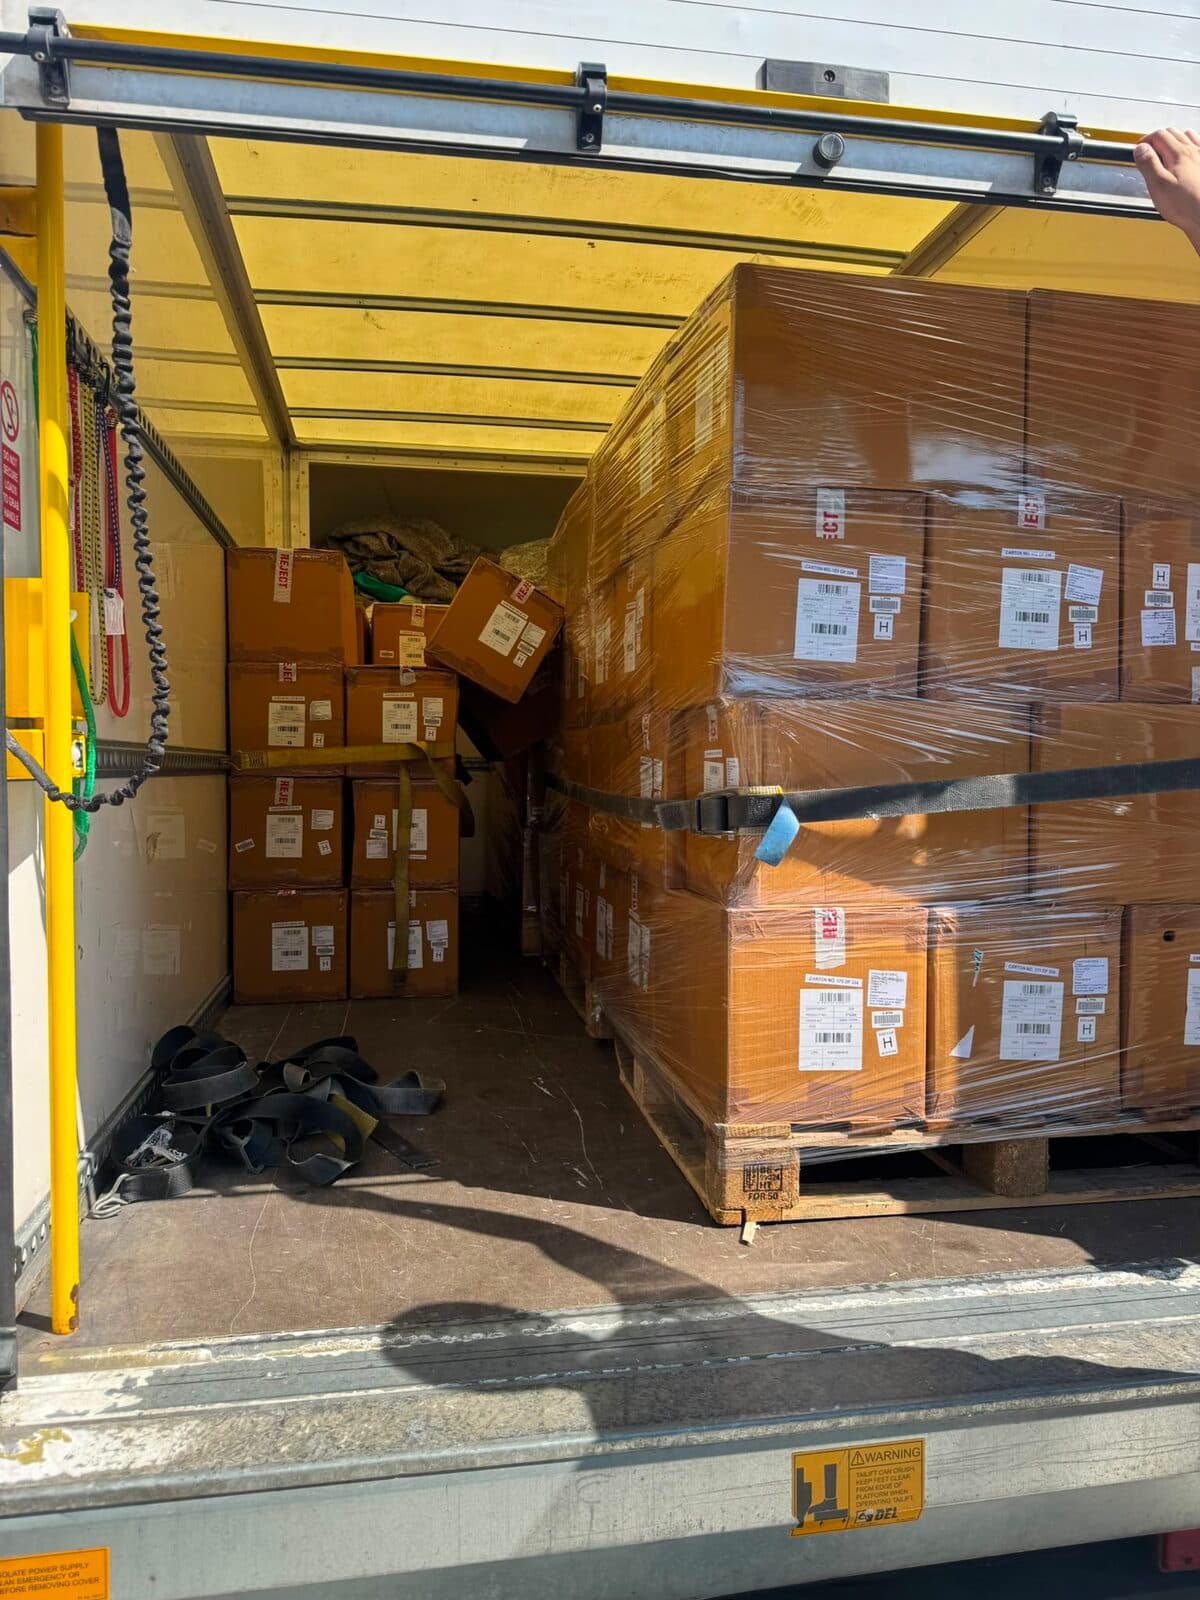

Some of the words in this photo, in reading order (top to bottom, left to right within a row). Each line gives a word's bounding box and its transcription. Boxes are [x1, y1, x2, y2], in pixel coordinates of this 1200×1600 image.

[278, 554, 290, 589] REJECT
[1156, 571, 1165, 582] H
[879, 621, 888, 633] H
[1078, 630, 1087, 642] H
[1082, 1023, 1091, 1035] H
[883, 1036, 893, 1049] H
[748, 1192, 766, 1200] FOR
[865, 1447, 920, 1462] WARNING
[879, 1468, 892, 1476] CAN
[893, 1465, 915, 1475] CRUSH
[856, 1477, 873, 1485] KEEP
[873, 1475, 889, 1484] FEET
[890, 1473, 911, 1482] CLEAR
[856, 1485, 875, 1493] FROM
[875, 1483, 893, 1491] EDGE
[856, 1491, 889, 1500] PLATFORM
[889, 1489, 909, 1497] WHEN
[856, 1498, 891, 1507] OPERATING
[28, 1566, 58, 1574] POWER
[59, 1562, 89, 1572] SUPPLY
[17, 1573, 66, 1584] EMERGENCY
[28, 1581, 71, 1592] REMOVING
[72, 1577, 100, 1586] COVER
